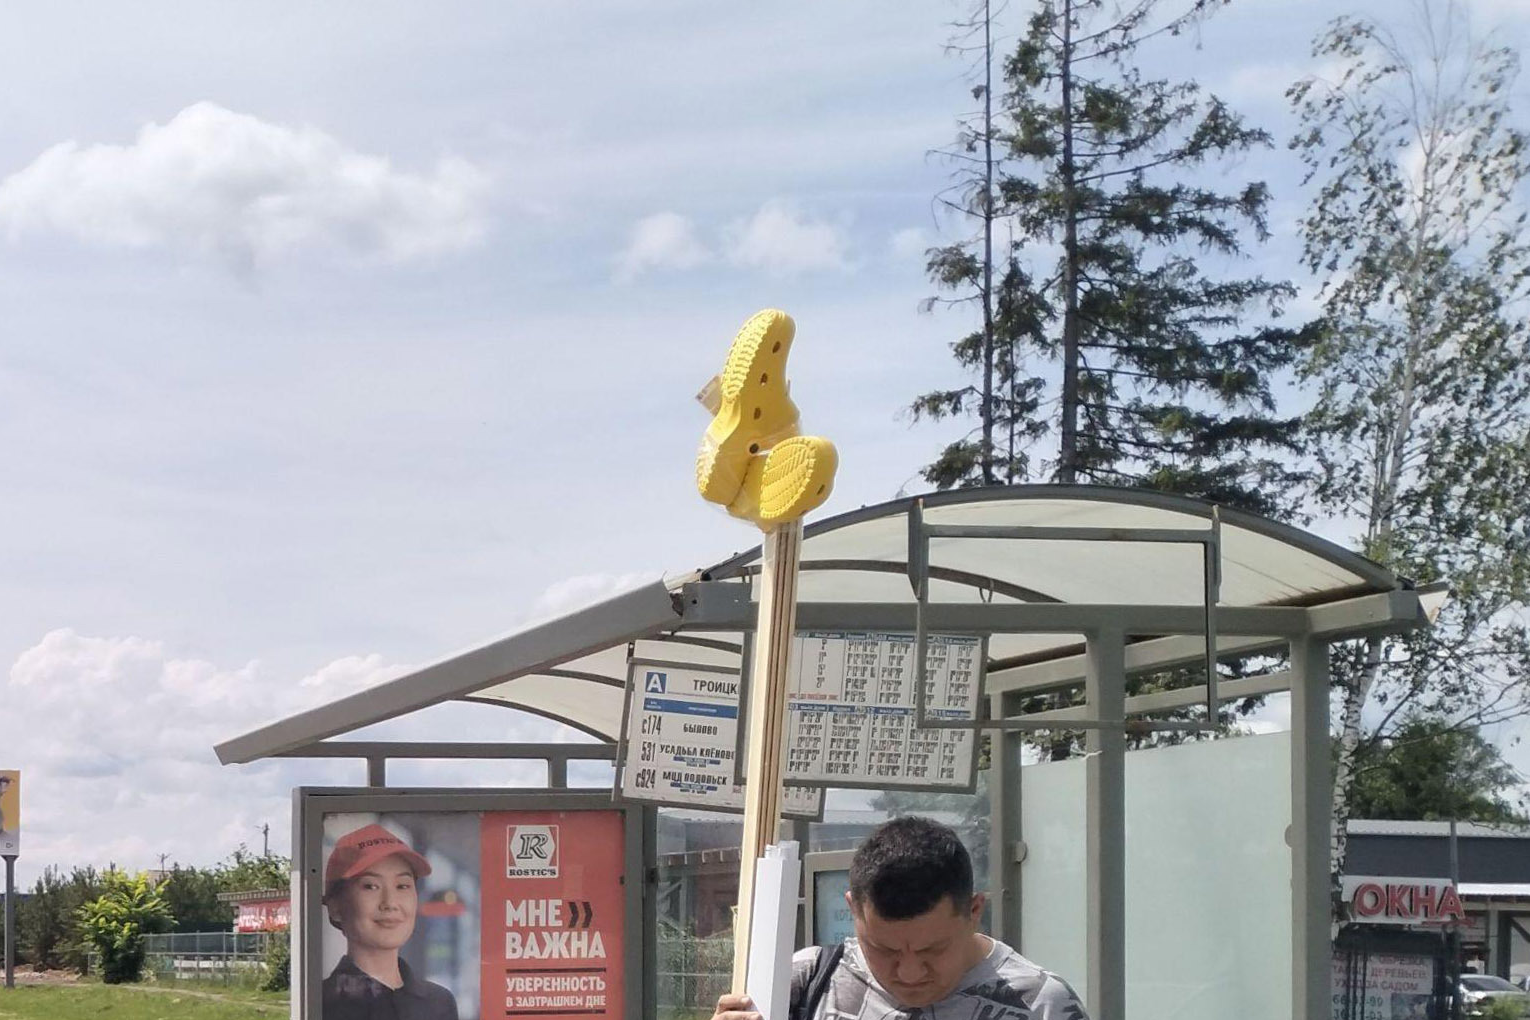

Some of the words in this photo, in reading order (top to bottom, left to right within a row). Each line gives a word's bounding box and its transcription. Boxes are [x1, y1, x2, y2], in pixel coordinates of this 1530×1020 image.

[693, 679, 738, 695] ТРОИЦК
[684, 773, 728, 786] ПОДОЛЬСК
[508, 868, 557, 877] ROSTIC'S
[1354, 882, 1466, 919] ОКНА
[505, 898, 563, 928] МНЕ
[505, 930, 607, 960] ВАЖНА
[506, 976, 606, 993] УВЕРЕННОСТЬ
[506, 998, 513, 1008] В
[515, 996, 583, 1008] ЗАВТРАШНЕМ
[585, 995, 606, 1009] ДНЕ
